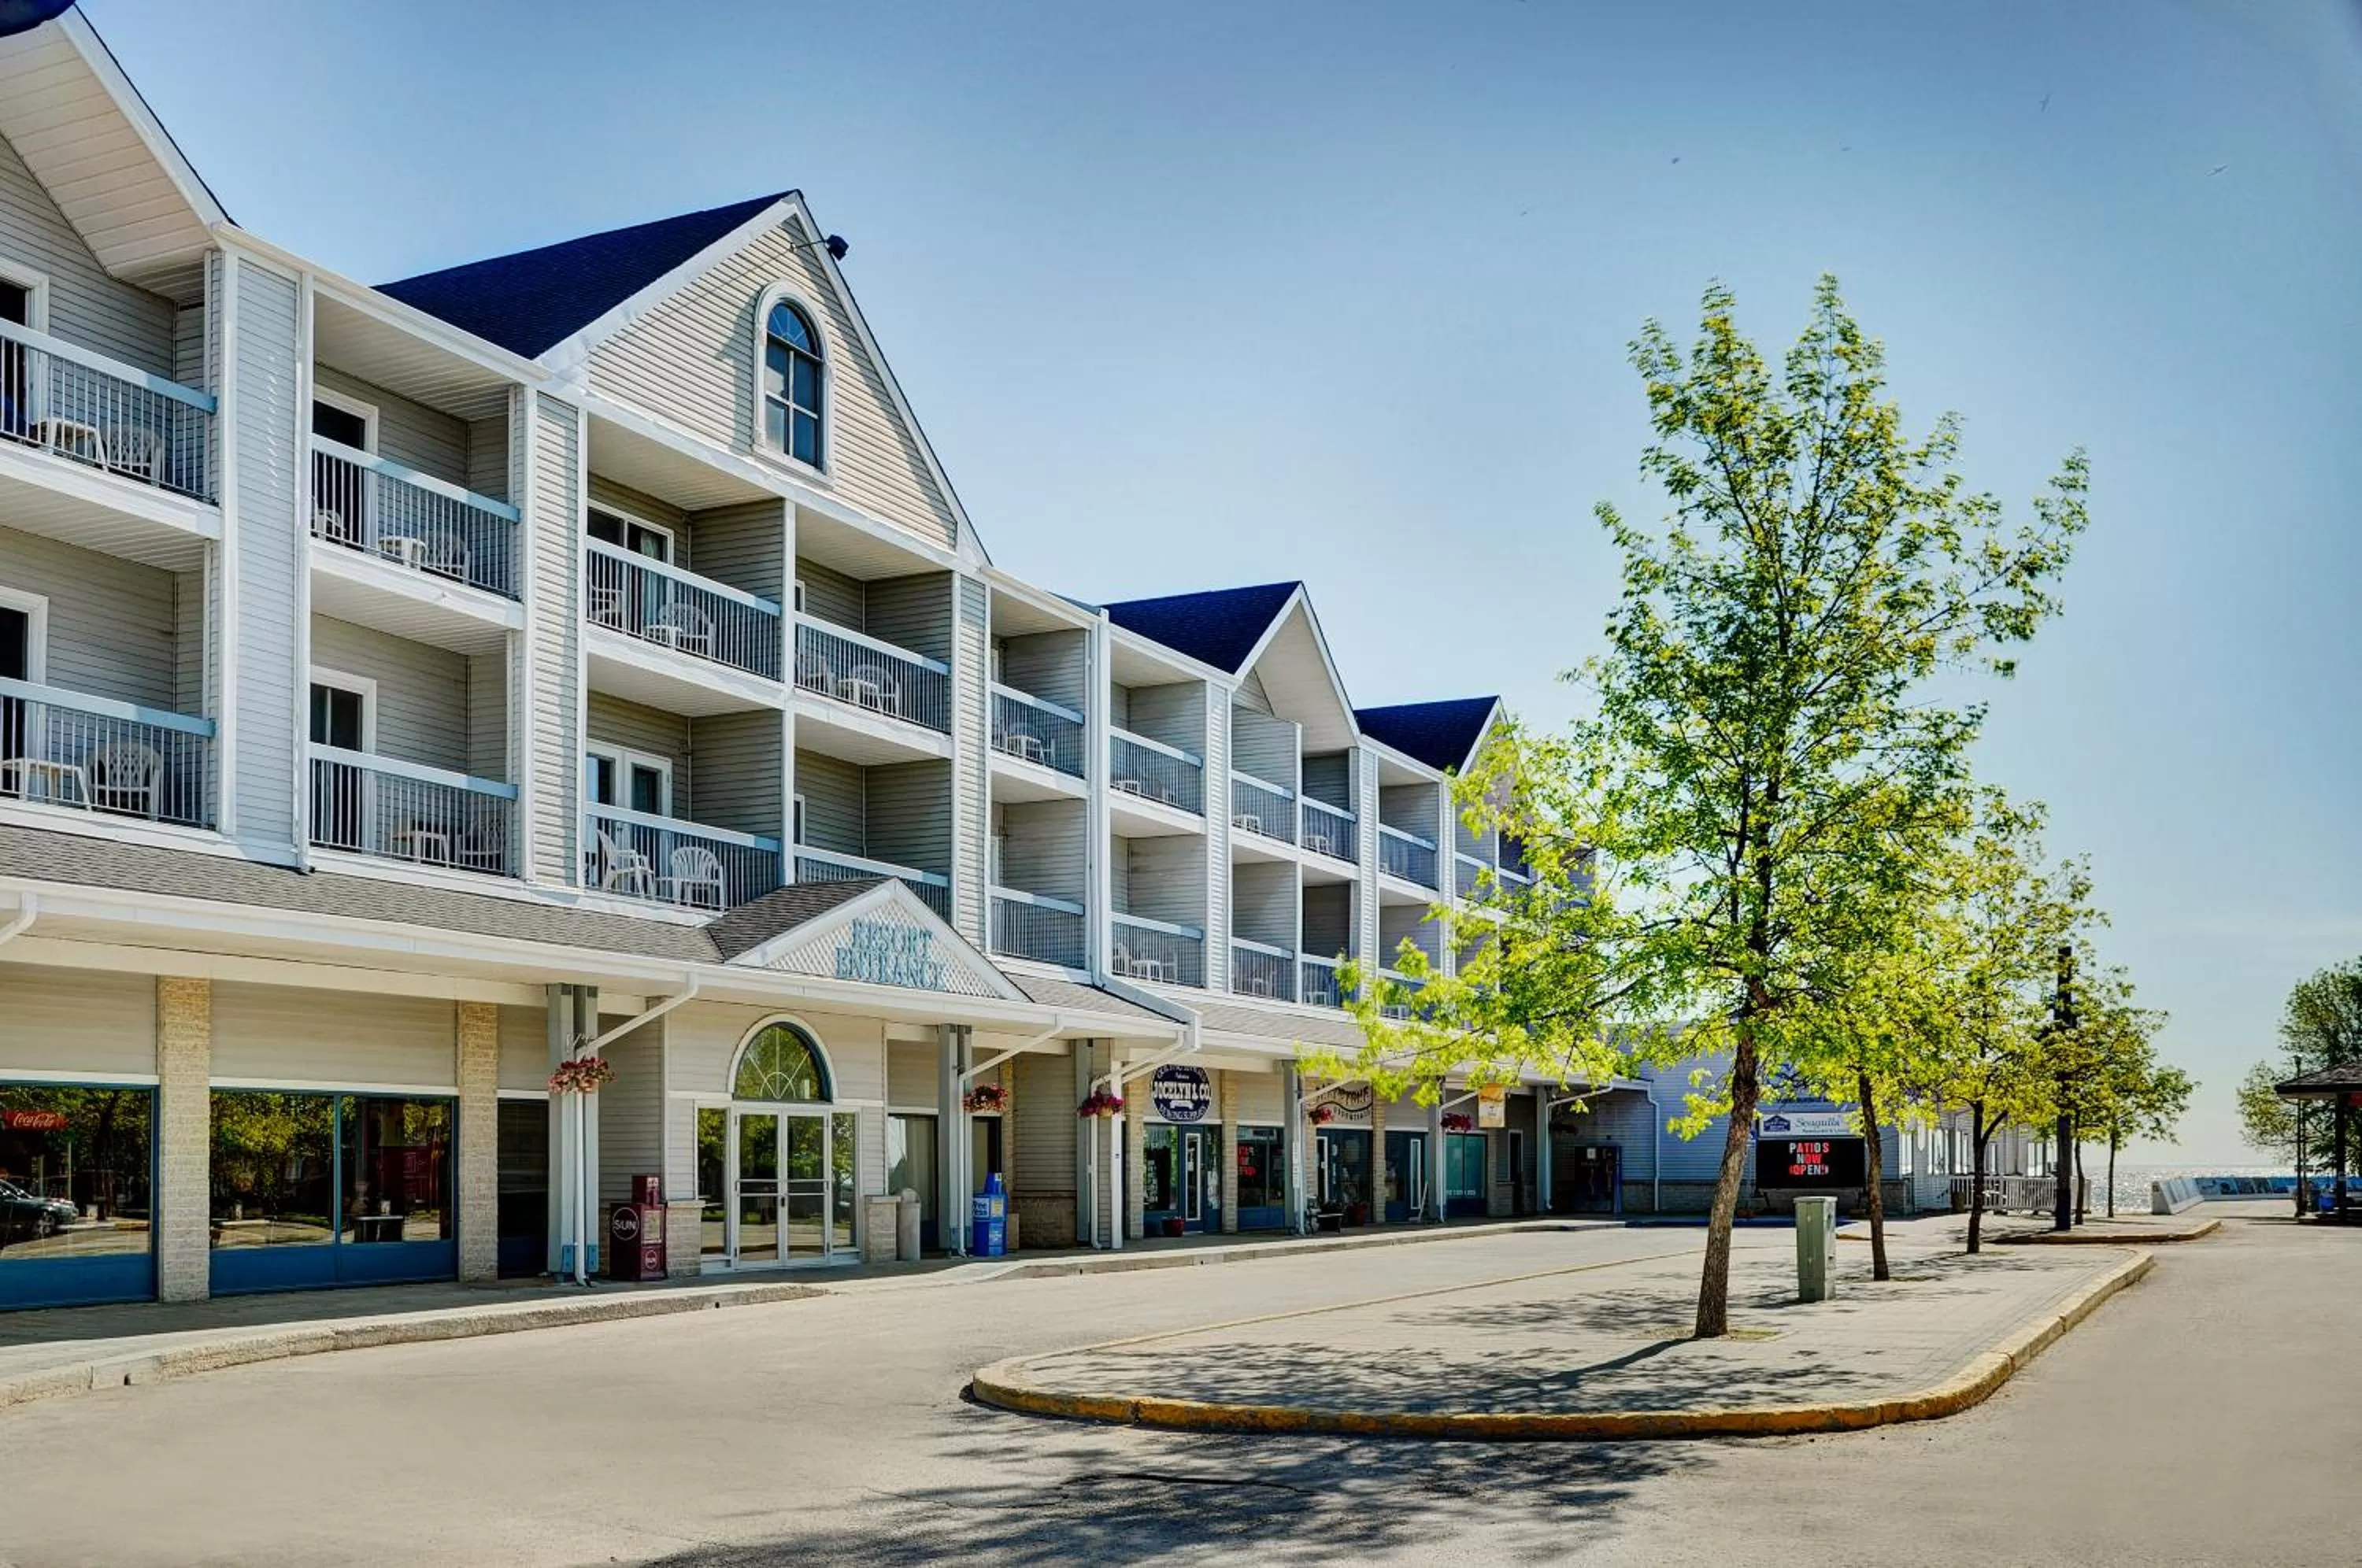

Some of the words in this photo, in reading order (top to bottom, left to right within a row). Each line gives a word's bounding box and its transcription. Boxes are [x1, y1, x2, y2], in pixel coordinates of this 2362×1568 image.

[852, 919, 932, 958] RESORT
[835, 947, 946, 991] ENTRANCE
[1789, 1142, 1830, 1154] PATIOS
[1796, 1153, 1822, 1164] NOW
[613, 1219, 636, 1230] SUN
